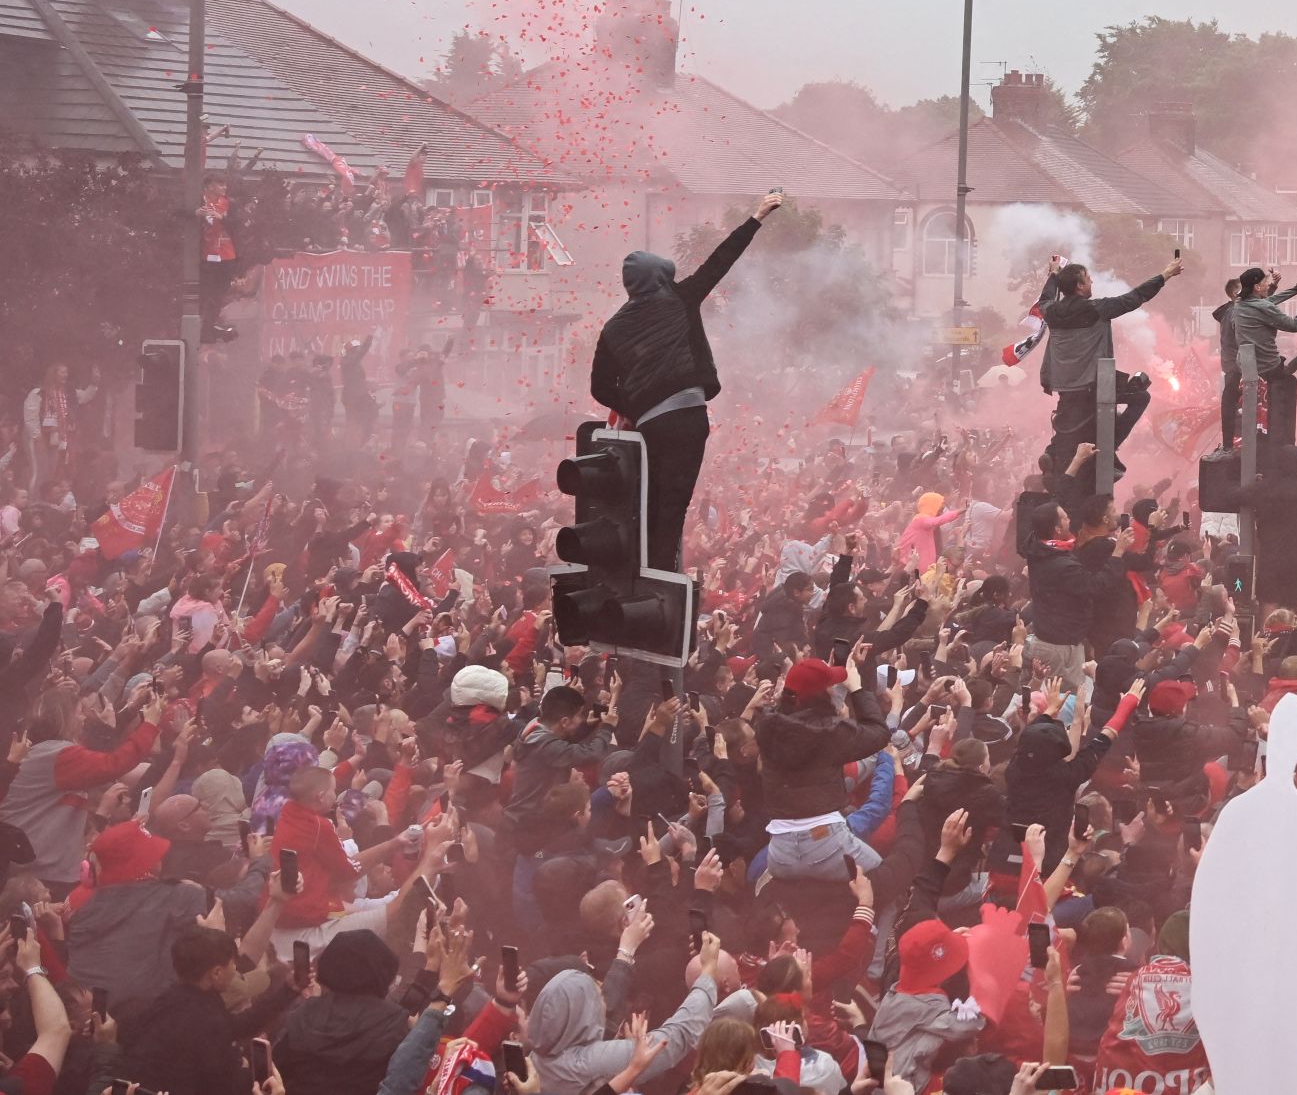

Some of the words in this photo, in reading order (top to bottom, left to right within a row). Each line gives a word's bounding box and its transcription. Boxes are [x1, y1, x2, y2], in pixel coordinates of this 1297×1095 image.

[274, 266, 312, 289] AND
[316, 264, 358, 287] WINS
[361, 266, 392, 287] THE
[272, 298, 395, 323] CHAMPIONSHP
